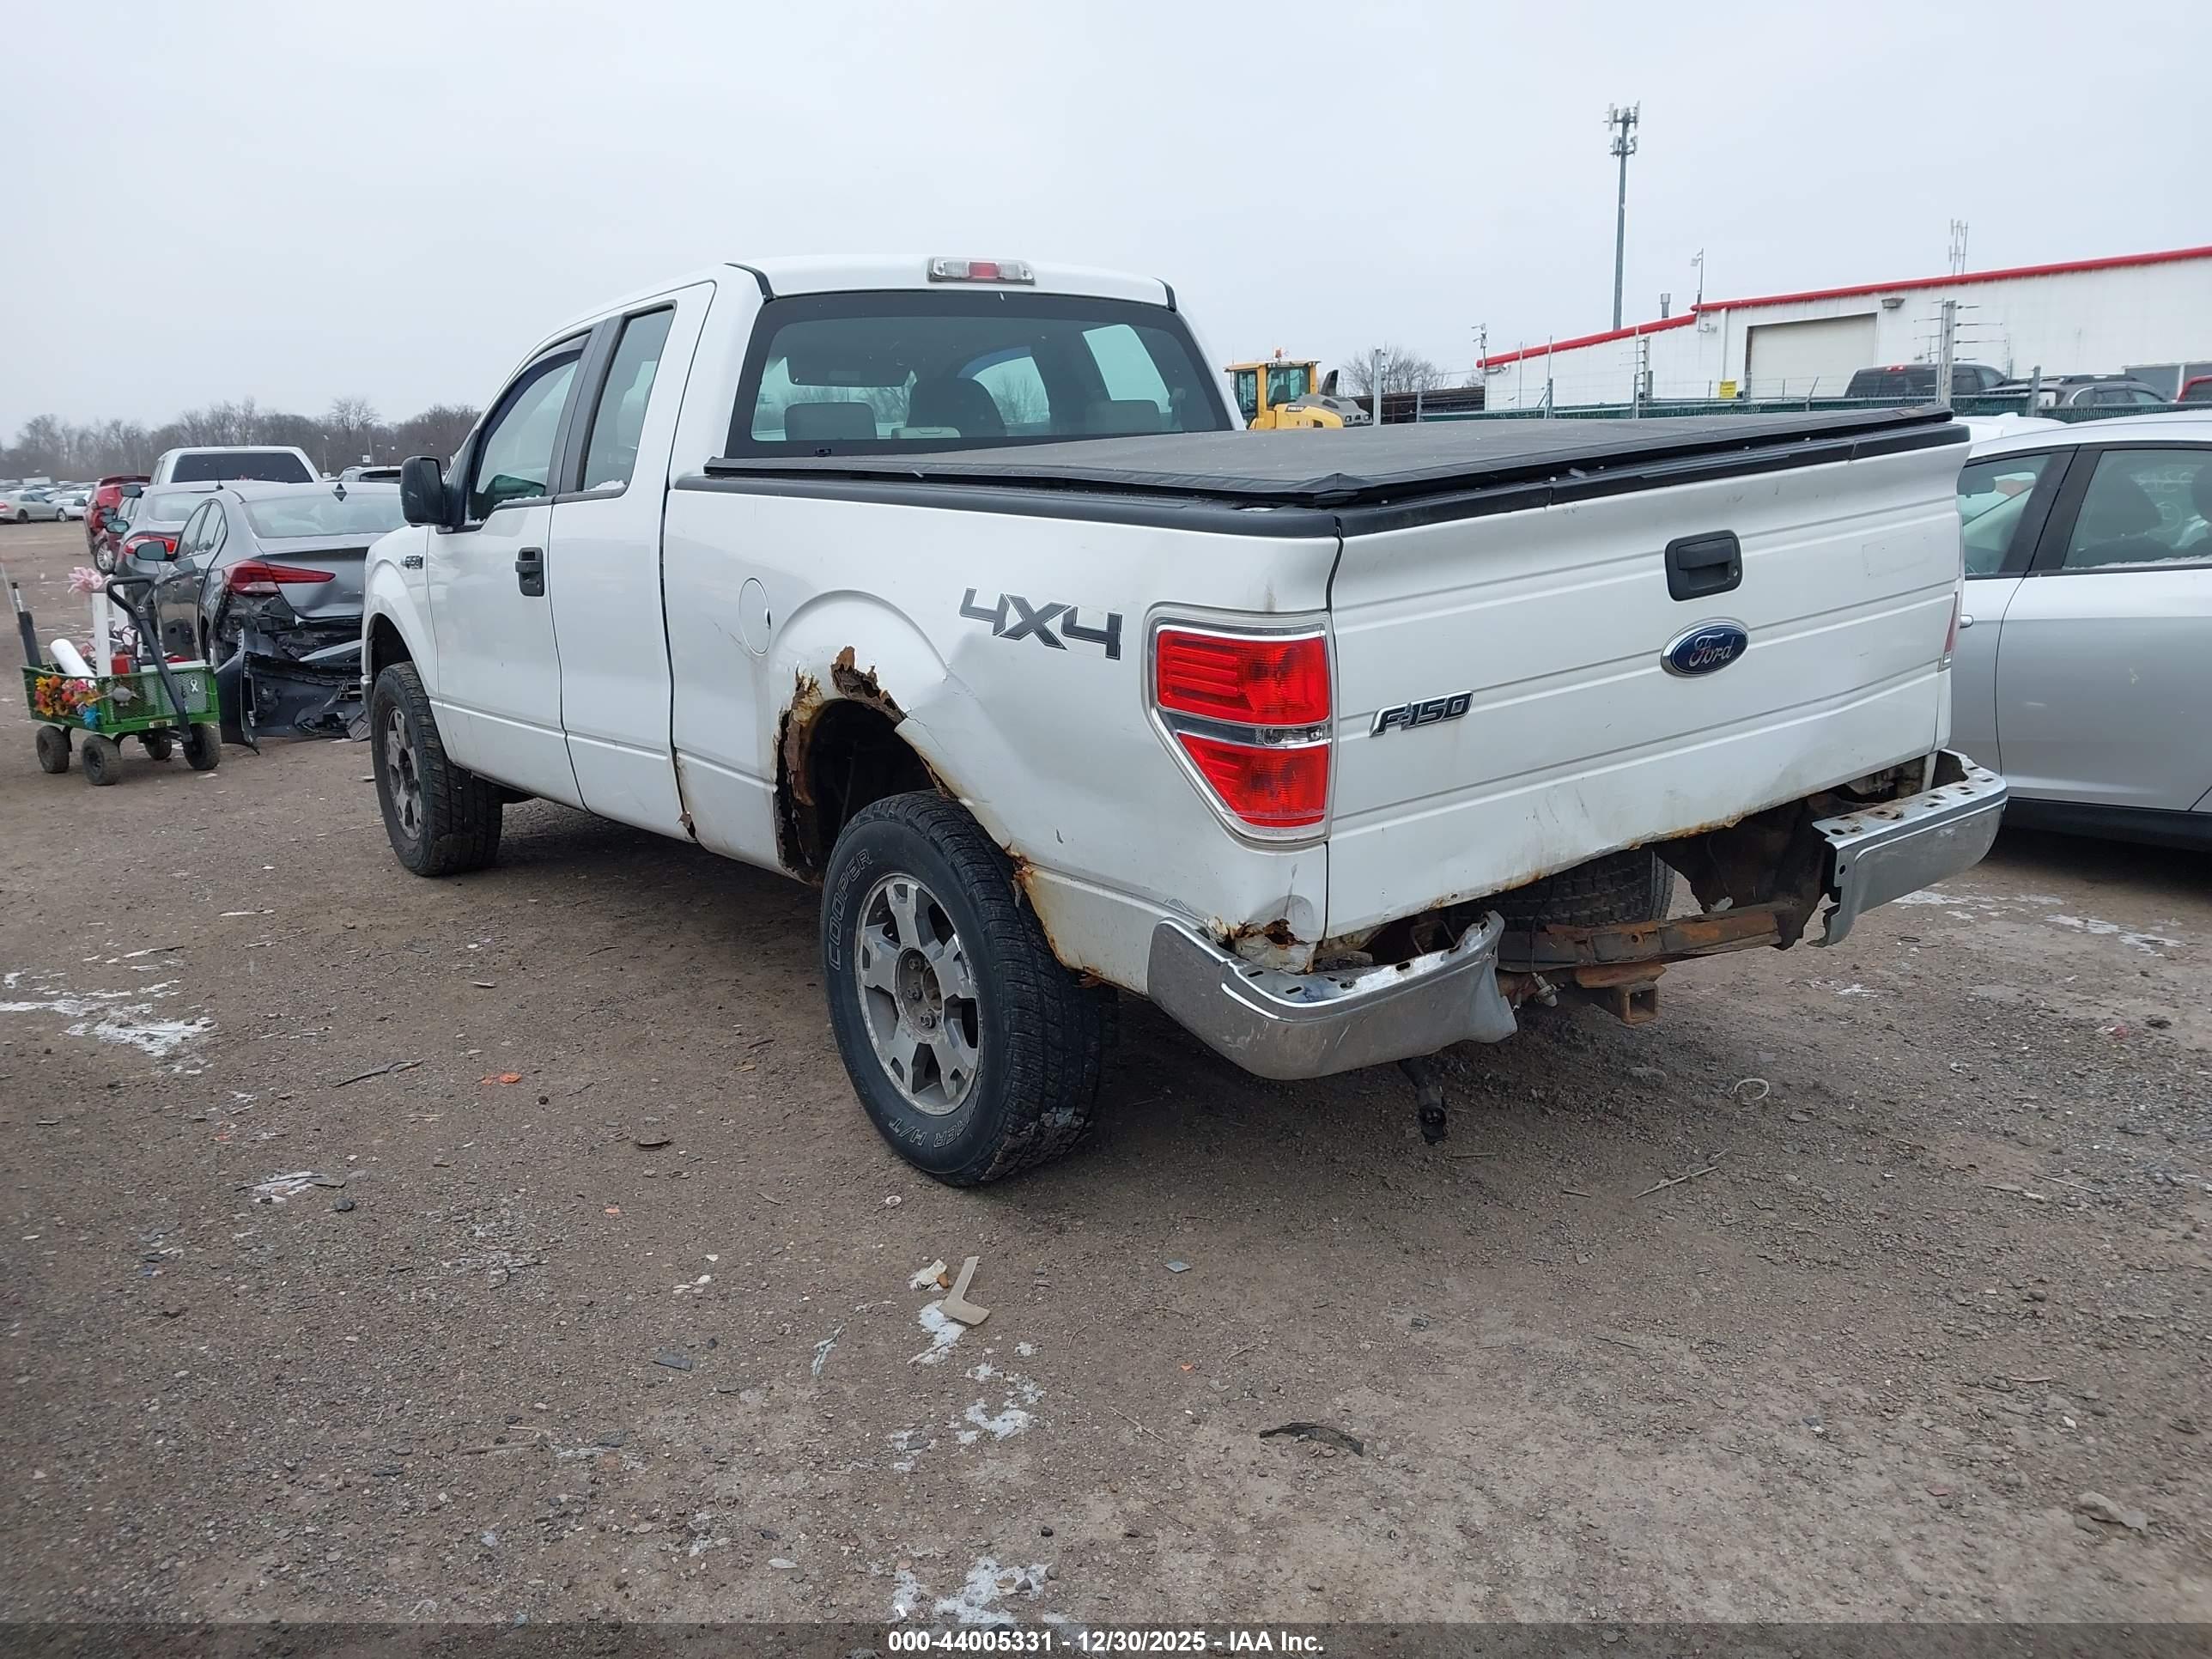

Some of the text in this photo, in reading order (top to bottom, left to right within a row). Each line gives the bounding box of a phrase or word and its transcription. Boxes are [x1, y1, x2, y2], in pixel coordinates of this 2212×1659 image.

[1688, 632, 1735, 667] Ford
[1369, 690, 1474, 738] F-150
[828, 848, 873, 971] COOPER
[888, 1118, 927, 1146] H/T
